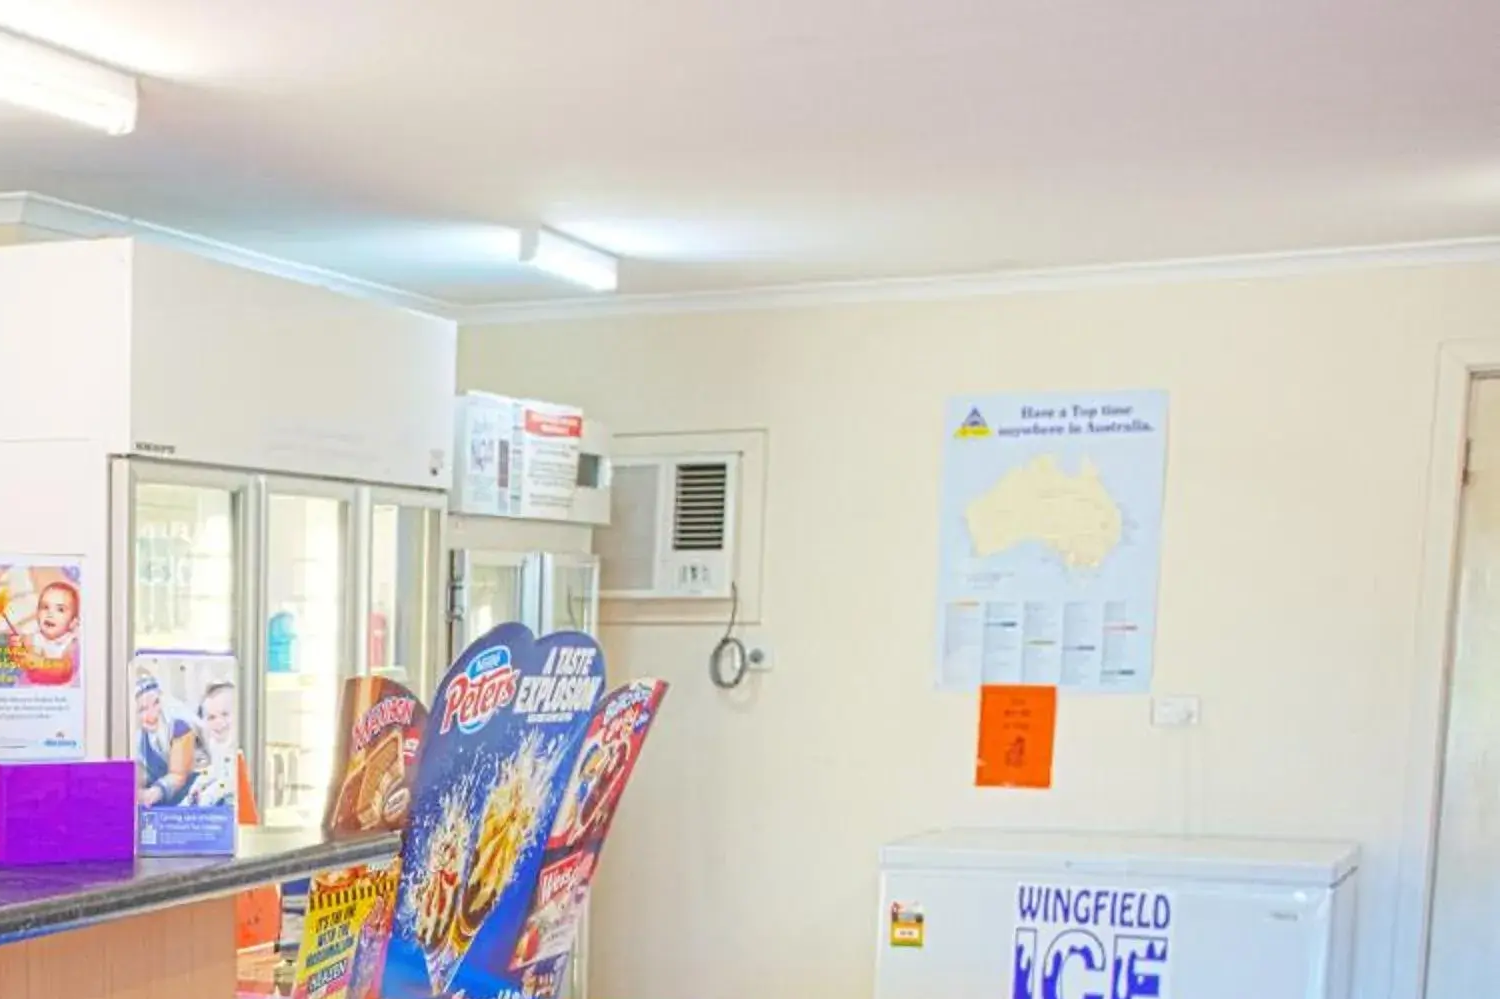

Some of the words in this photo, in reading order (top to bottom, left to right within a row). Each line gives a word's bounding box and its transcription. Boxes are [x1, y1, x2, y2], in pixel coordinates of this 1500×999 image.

[1021, 406, 1055, 420] Have
[1059, 408, 1067, 418] a
[1072, 405, 1098, 419] Top
[1101, 404, 1134, 416] time
[998, 422, 1065, 437] anywhere
[1068, 421, 1081, 434] in
[542, 646, 559, 675] A
[556, 647, 597, 675] TASTE
[440, 666, 521, 735] Peters
[512, 676, 602, 714] EXPLOSION
[1017, 885, 1172, 930] WINGFIELD
